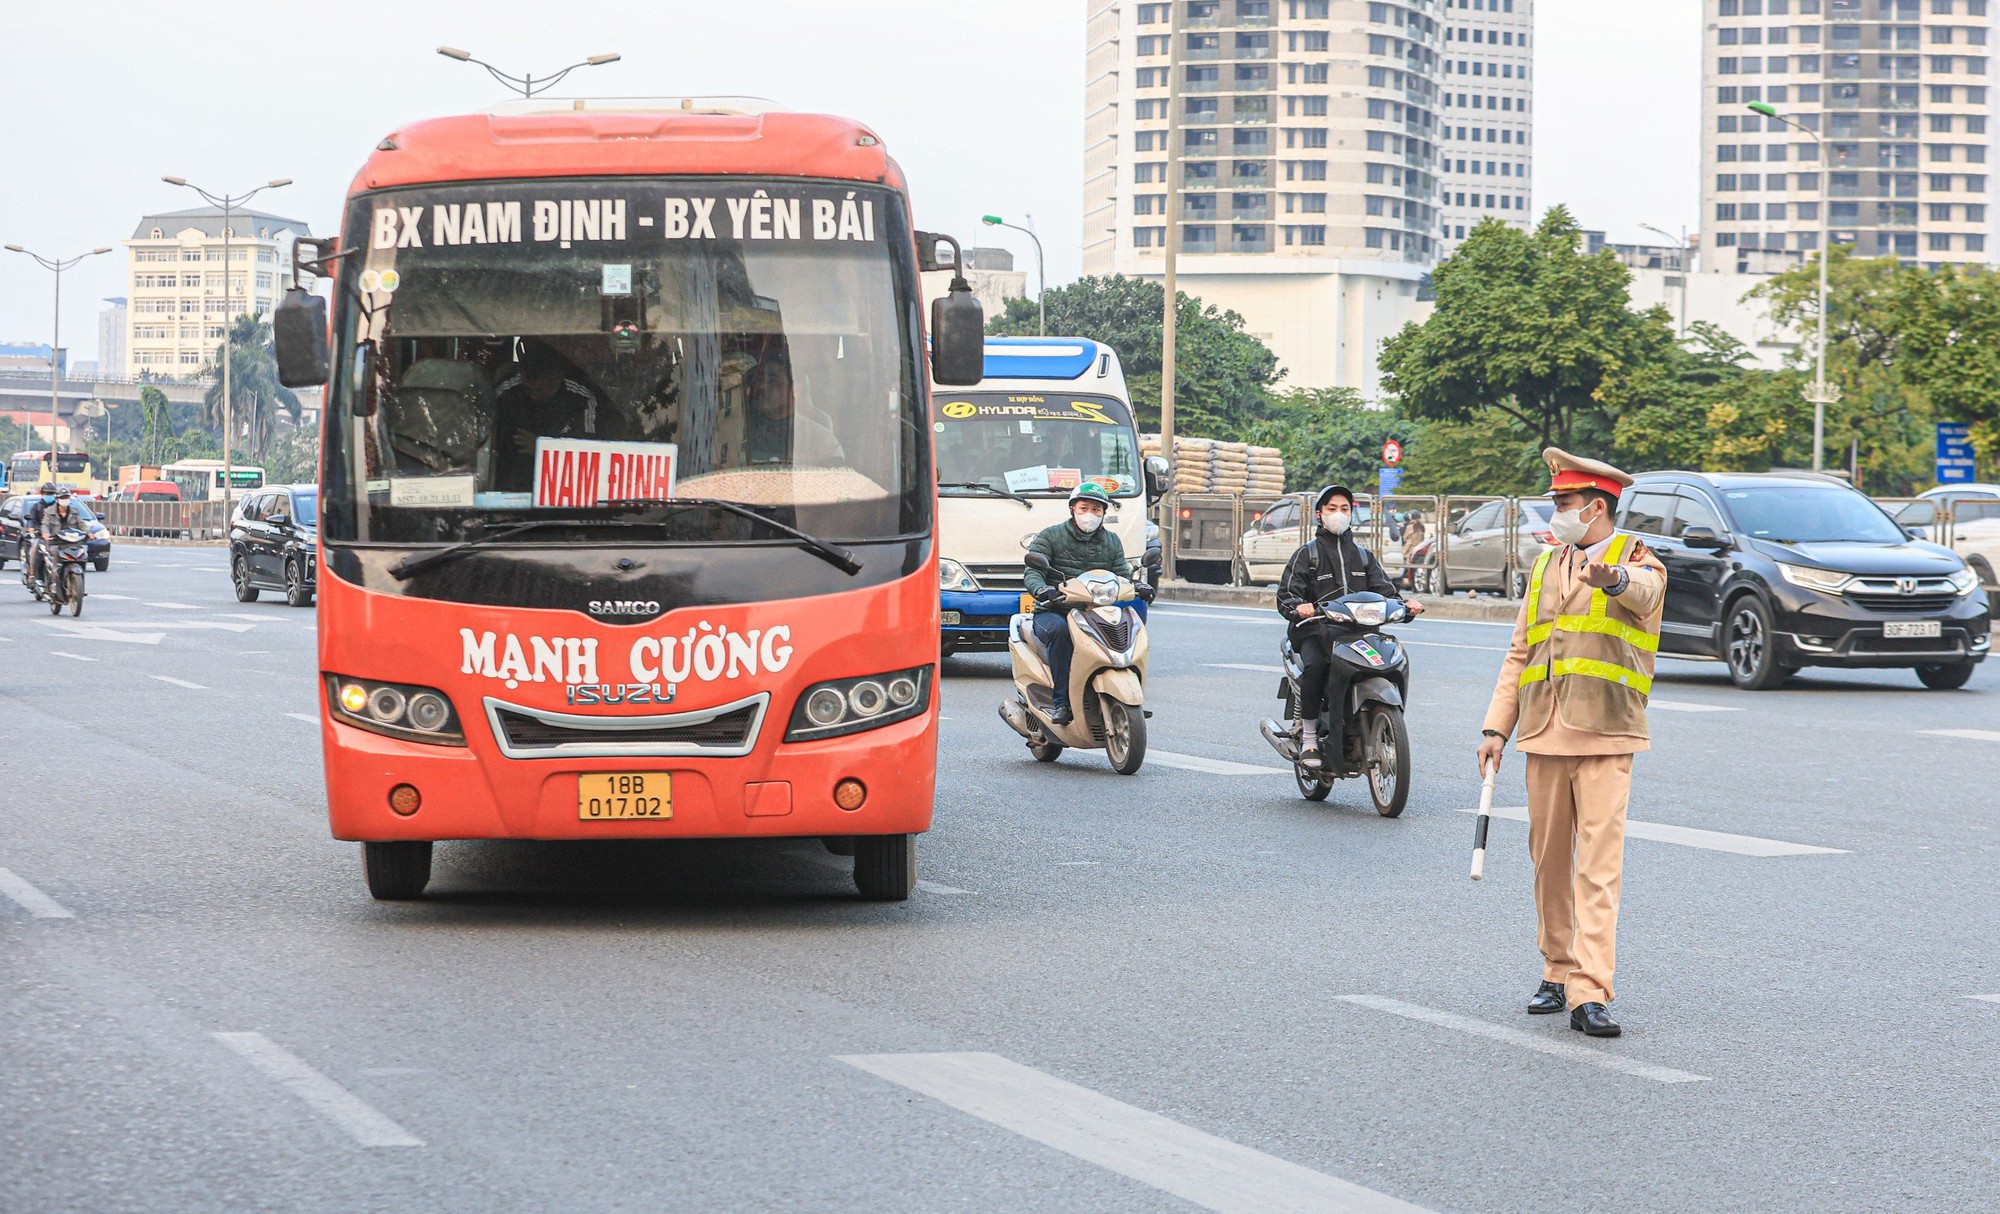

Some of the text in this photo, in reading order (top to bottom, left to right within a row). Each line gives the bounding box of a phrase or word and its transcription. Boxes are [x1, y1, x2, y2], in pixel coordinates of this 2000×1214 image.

[373, 206, 424, 249] BX
[433, 201, 521, 246] NAM
[532, 199, 626, 249] ĐỊNH
[665, 198, 716, 239] BX
[726, 189, 801, 240] YÊN
[812, 191, 875, 241] BÁI
[978, 405, 1037, 415] HYUNDAI
[538, 449, 601, 508] NAM
[588, 600, 661, 615] SAMCO
[459, 620, 794, 689] MẠNH CƯỜNG
[566, 683, 677, 705] ISUZU
[608, 776, 644, 794] 18B
[590, 797, 661, 816] 017.02
